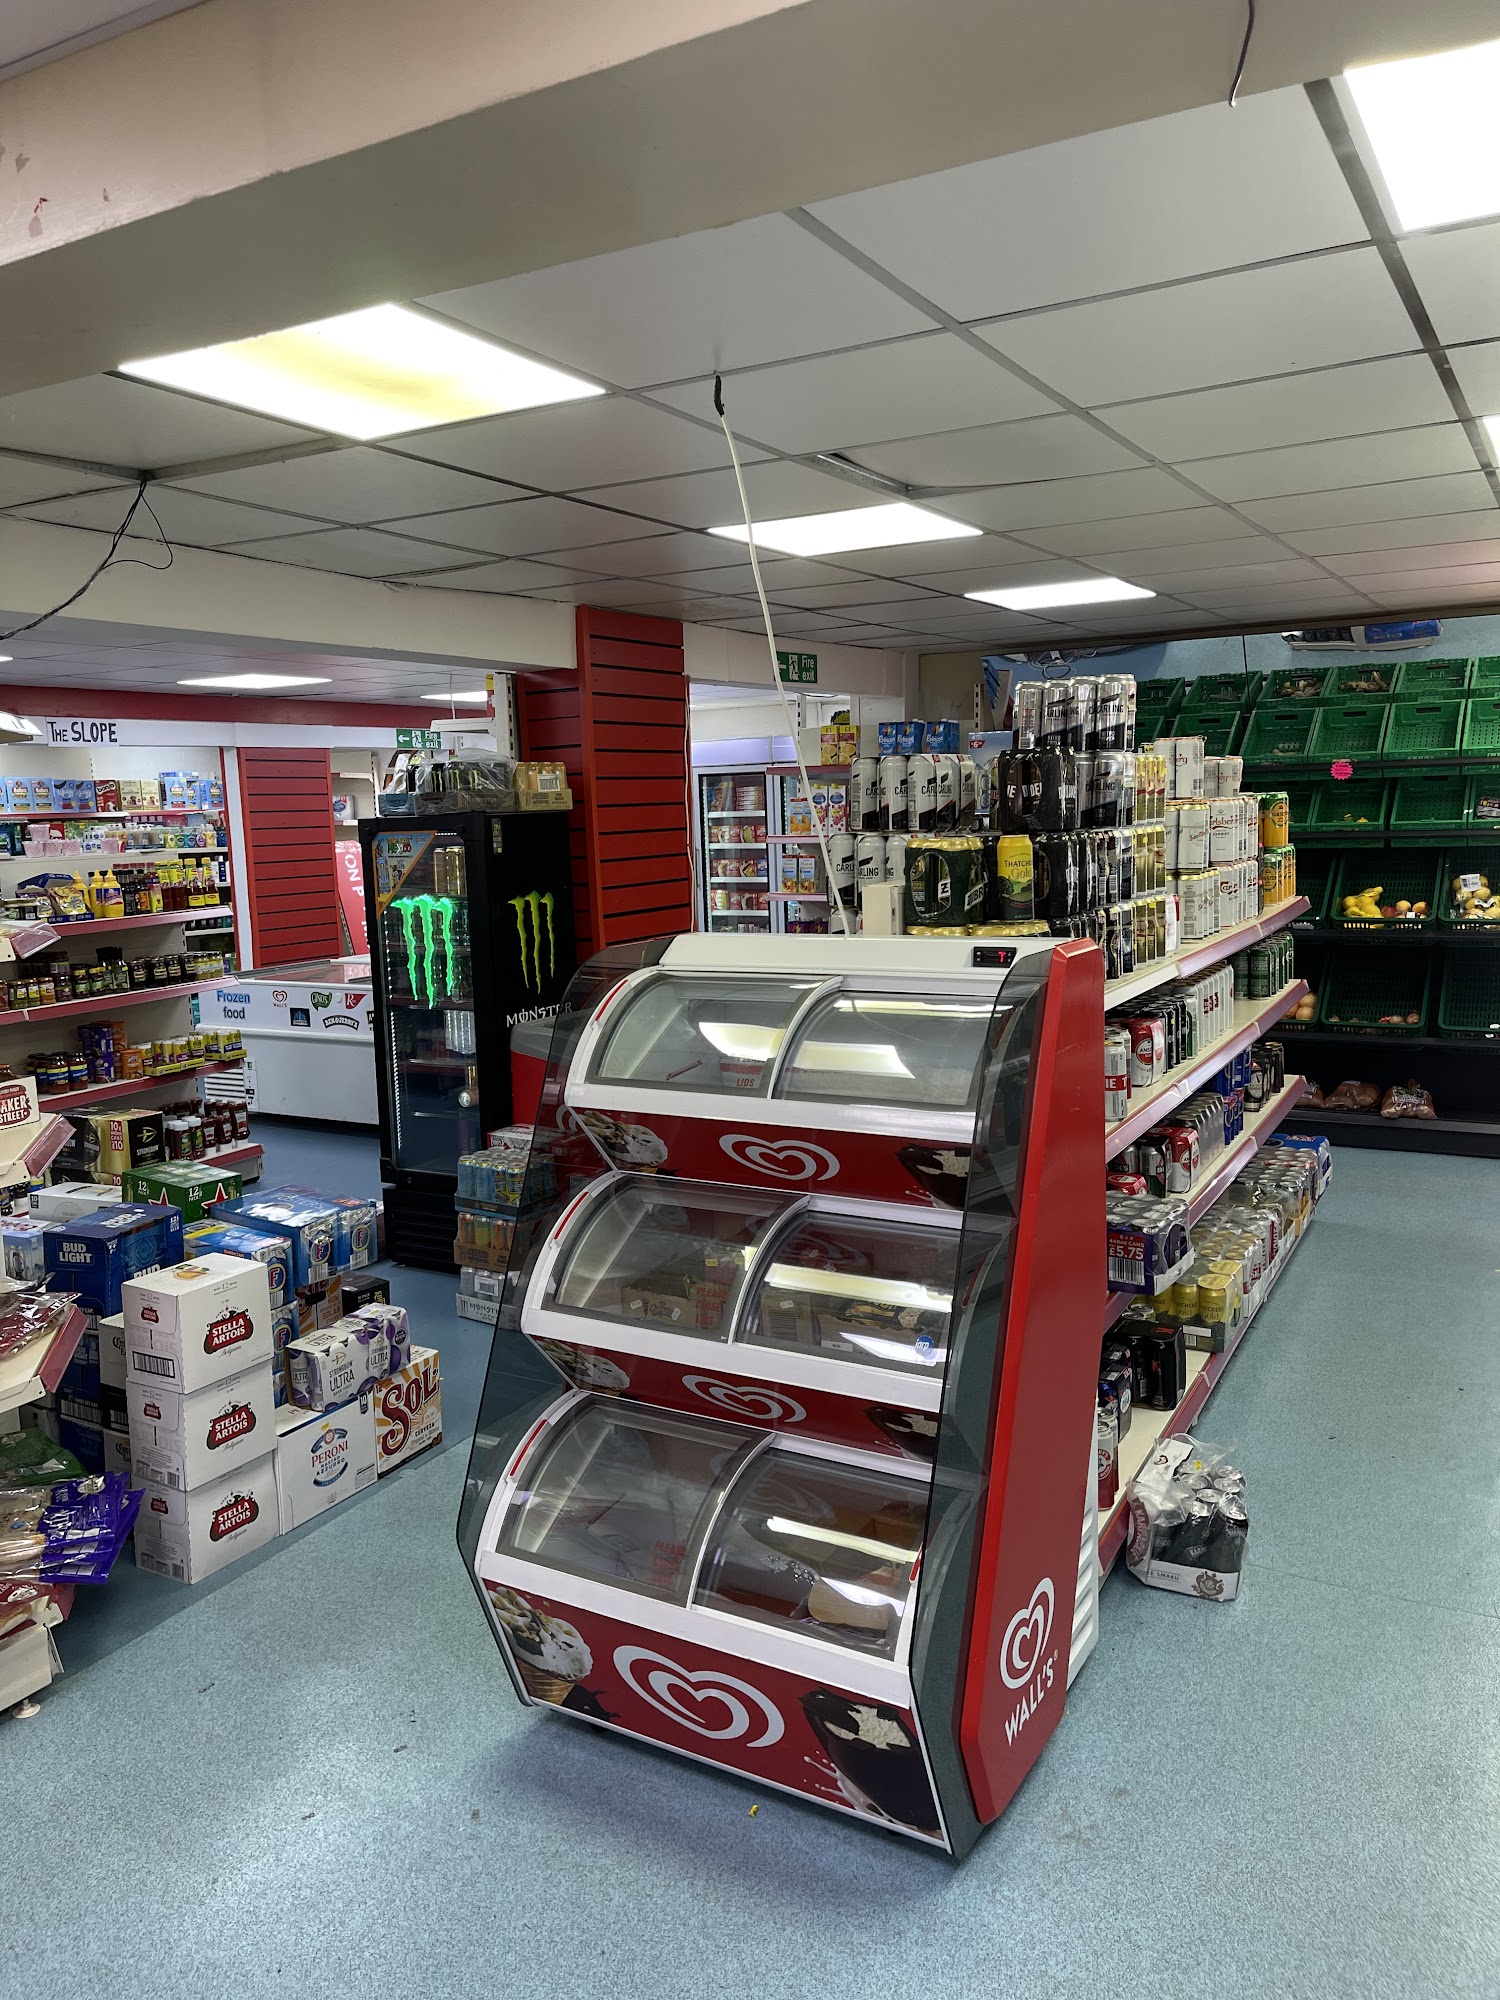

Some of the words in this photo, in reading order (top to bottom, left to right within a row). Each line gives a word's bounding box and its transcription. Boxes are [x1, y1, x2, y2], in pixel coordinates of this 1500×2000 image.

[801, 655, 815, 668] Fire
[802, 669, 815, 681] exit
[70, 721, 118, 743] SLOPE
[424, 731, 438, 740] Fire
[425, 740, 439, 748] exit
[938, 784, 953, 794] CARLING
[1010, 867, 1033, 881] Gold
[216, 990, 251, 1004] Frozen
[223, 1007, 246, 1020] food
[736, 1077, 755, 1087] LIDS
[138, 1181, 147, 1192] 12
[188, 1186, 199, 1197] 12
[62, 1241, 87, 1253] BUD
[1109, 1246, 1144, 1260] £5.75
[59, 1251, 93, 1263] LIGHT
[269, 1267, 280, 1289] F
[696, 1286, 729, 1300] PLEASE
[211, 1318, 245, 1338] STELLA
[212, 1326, 246, 1346] ARTOIS
[370, 1351, 388, 1366] ULTRA
[328, 1360, 353, 1378] STRONGBOW
[329, 1369, 355, 1392] ULTRA
[375, 1383, 383, 1394] 12
[360, 1393, 367, 1402] 10
[381, 1366, 439, 1457] SOL
[215, 1411, 248, 1432] STELLA
[215, 1419, 248, 1441] ARTOIS
[414, 1422, 435, 1437] CERVEZA
[311, 1440, 349, 1468] PERONI
[316, 1457, 345, 1476] AZZURRO
[217, 1502, 250, 1523] STELLA
[218, 1510, 251, 1532] ARTOIS
[1157, 1571, 1180, 1581] SMAKU
[1004, 1658, 1054, 1747] WALL'S
